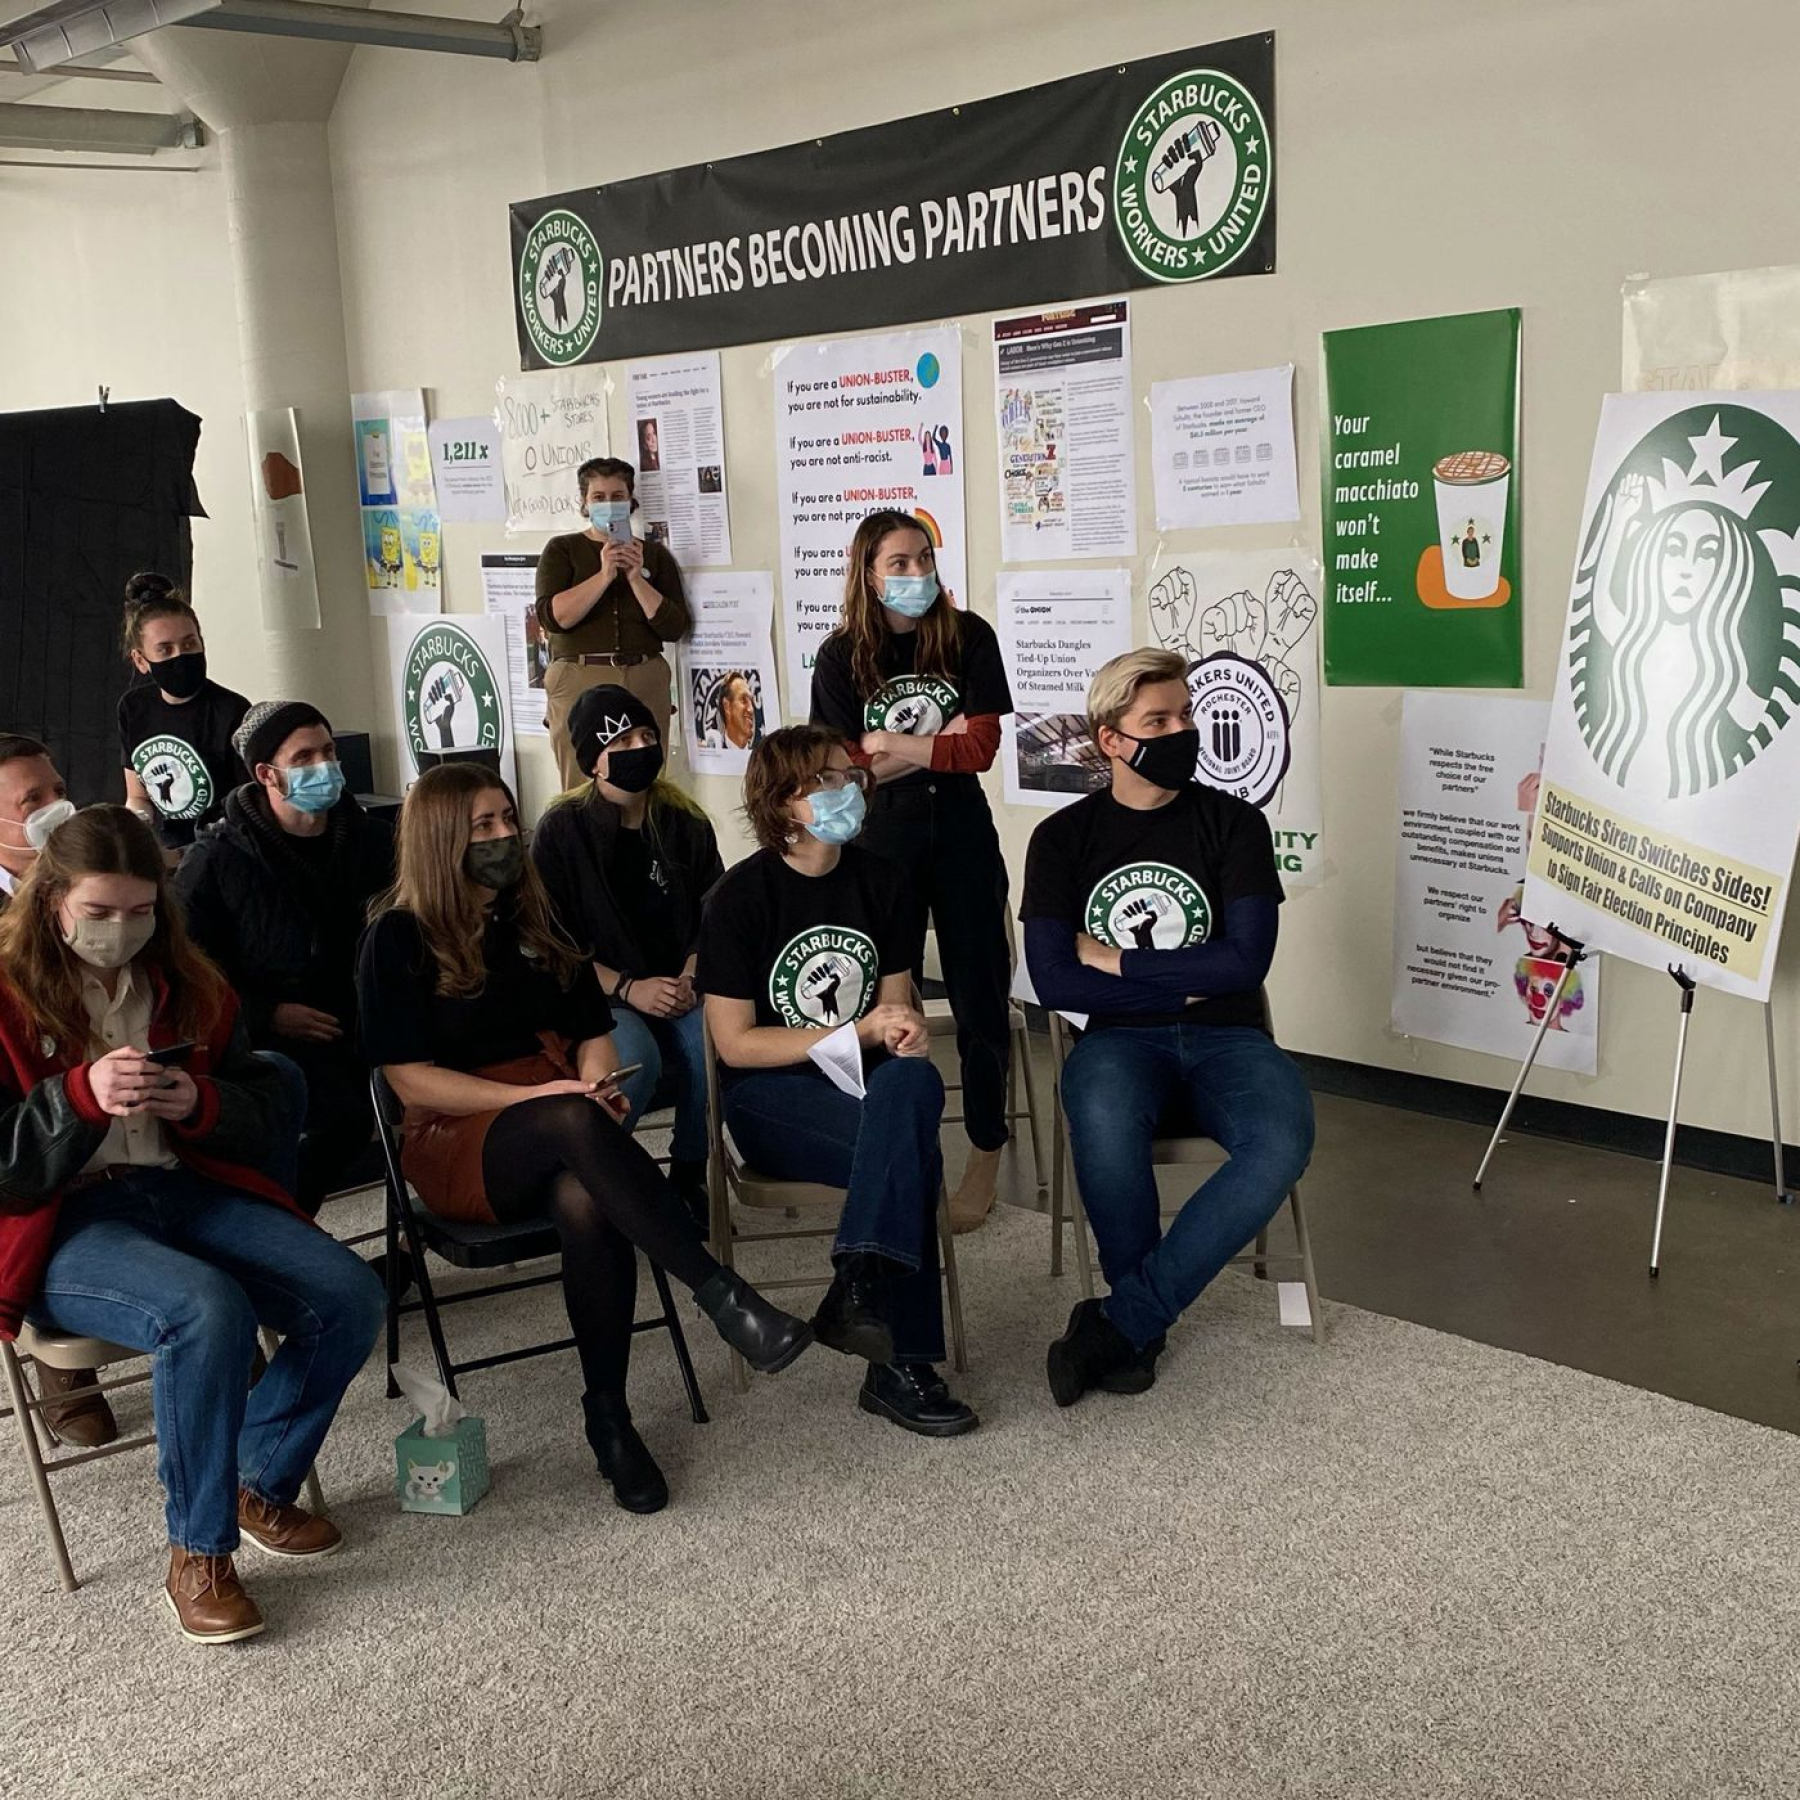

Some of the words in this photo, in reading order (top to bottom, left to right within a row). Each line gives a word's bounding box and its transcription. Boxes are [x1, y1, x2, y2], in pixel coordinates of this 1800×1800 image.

[1137, 83, 1251, 146] STARBUCKS
[1208, 164, 1261, 254] UNITED
[607, 237, 743, 307] PARTNERS
[749, 205, 915, 288] BECOMING
[920, 166, 1105, 259] PARTNERS
[1121, 184, 1188, 268] WORKERS
[530, 220, 592, 263] STARBUCKS
[525, 291, 564, 355] WORKERS
[573, 280, 596, 345] UNITED
[787, 381, 794, 393] If
[795, 382, 811, 396] you
[813, 380, 828, 391] are
[831, 380, 837, 389] a
[839, 369, 913, 388] UNION-BUSTER,
[788, 402, 804, 415] you
[806, 400, 821, 410] are
[823, 397, 839, 409] not
[841, 394, 855, 407] for
[856, 388, 922, 406] sustainability.
[1335, 415, 1370, 436] Your
[790, 437, 796, 449] If
[797, 438, 814, 452] you
[815, 437, 831, 447] are
[833, 437, 839, 446] a
[841, 428, 915, 446] UNION-BUSTER,
[443, 442, 477, 464] 1,211
[790, 458, 806, 470] you
[808, 456, 824, 466] are
[826, 453, 841, 465] not
[843, 451, 892, 464] anti-racist.
[1335, 443, 1401, 469] caramel
[792, 491, 798, 504] If
[800, 493, 816, 506] you
[818, 492, 833, 502] are
[835, 492, 842, 501] a
[843, 487, 918, 502] UNION-BUSTER,
[1335, 479, 1419, 503] macchiato
[793, 512, 810, 525] you
[811, 511, 826, 521] are
[828, 509, 843, 520] not
[1336, 513, 1380, 536] won't
[794, 547, 800, 558] If
[802, 548, 818, 562] you
[820, 548, 835, 558] are
[837, 548, 844, 558] a
[1336, 548, 1378, 570] make
[795, 566, 810, 579] you
[812, 566, 828, 576] are
[830, 564, 845, 576] not
[1336, 581, 1392, 603] itself...
[797, 600, 802, 612] If
[804, 604, 820, 615] you
[822, 604, 837, 612] are
[797, 622, 813, 633] you
[1016, 640, 1056, 649] Starbucks
[1058, 640, 1091, 651] Dangles
[411, 635, 478, 681] STARBUCKS
[1016, 653, 1049, 665] Tied-Up
[1051, 654, 1076, 663] Union
[1017, 667, 1061, 678] Organizers
[1063, 668, 1083, 677] Over
[1017, 681, 1028, 690] Of
[1029, 682, 1063, 691] Steamed
[1066, 682, 1084, 691] Milk
[1189, 668, 1232, 698] RKERS
[1235, 671, 1275, 722] UNITED
[1200, 692, 1252, 715] ROCHESTER
[140, 741, 199, 774] STARBUCKS
[1455, 750, 1495, 761] Starbucks
[1224, 765, 1240, 775] JOINT
[1430, 760, 1462, 769] respects
[1479, 764, 1493, 773] free
[1436, 771, 1461, 779] choice
[1417, 810, 1437, 821] firmly
[1440, 812, 1466, 823] believe
[1469, 817, 1484, 826] that
[1501, 822, 1520, 831] work
[1274, 831, 1318, 850] ITY
[1401, 831, 1446, 844] outstanding
[1448, 837, 1503, 851] compensation
[1505, 846, 1520, 854] and
[1454, 827, 1485, 837] coupled
[1488, 831, 1504, 840] with
[1410, 854, 1457, 868] unnecessary
[1459, 860, 1467, 868] at
[1450, 848, 1476, 859] makes
[1478, 853, 1504, 863] unions
[1544, 791, 1601, 838] Starbucks
[1600, 818, 1638, 856] Siren
[1638, 836, 1711, 888] Switches
[1712, 867, 1773, 911] Sides!
[1102, 870, 1197, 905] STARBUCKS
[1541, 822, 1584, 862] Supports
[1584, 842, 1617, 879] Union
[1618, 866, 1626, 884] &
[1628, 868, 1663, 901] Calls
[1664, 885, 1683, 910] on
[1683, 892, 1757, 943] Company
[1427, 886, 1439, 895] We
[1441, 889, 1469, 902] respect
[1471, 894, 1484, 902] our
[1439, 911, 1471, 923] organize
[1459, 902, 1476, 914] right
[1478, 906, 1486, 915] to
[1547, 859, 1557, 879] to
[1557, 863, 1580, 892] Sign
[1580, 876, 1603, 905] Fair
[1602, 887, 1652, 930] Election
[1654, 912, 1729, 965] Principles
[786, 933, 872, 970] STARBUCKS
[1417, 944, 1428, 953] but
[1430, 946, 1457, 959] believe
[1459, 952, 1474, 962] that
[1476, 954, 1493, 966] they
[1407, 965, 1445, 979] necessary
[1448, 971, 1467, 983] given
[1469, 976, 1482, 985] our
[1423, 957, 1447, 968] would
[1448, 962, 1461, 971] not
[1462, 964, 1477, 973] find
[1480, 967, 1485, 975] it
[1412, 977, 1440, 988] partner
